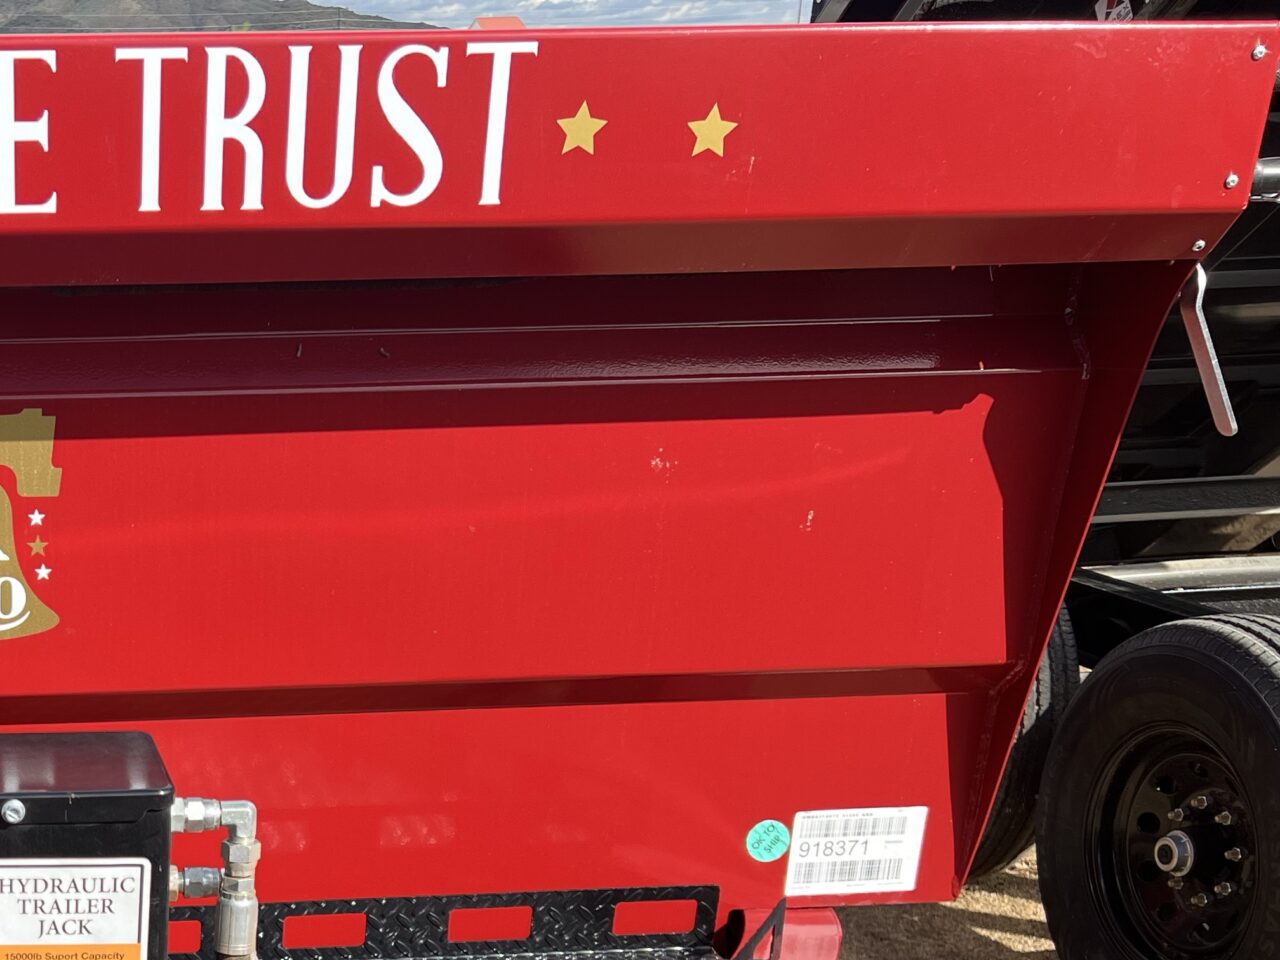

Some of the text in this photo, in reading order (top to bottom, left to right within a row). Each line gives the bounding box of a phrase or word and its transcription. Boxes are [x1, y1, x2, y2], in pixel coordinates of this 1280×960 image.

[115, 41, 538, 213] TRUST
[799, 839, 869, 858] 918371
[17, 898, 115, 915] TRAILER
[38, 919, 93, 939] JACK
[5, 953, 42, 960] 15000lb
